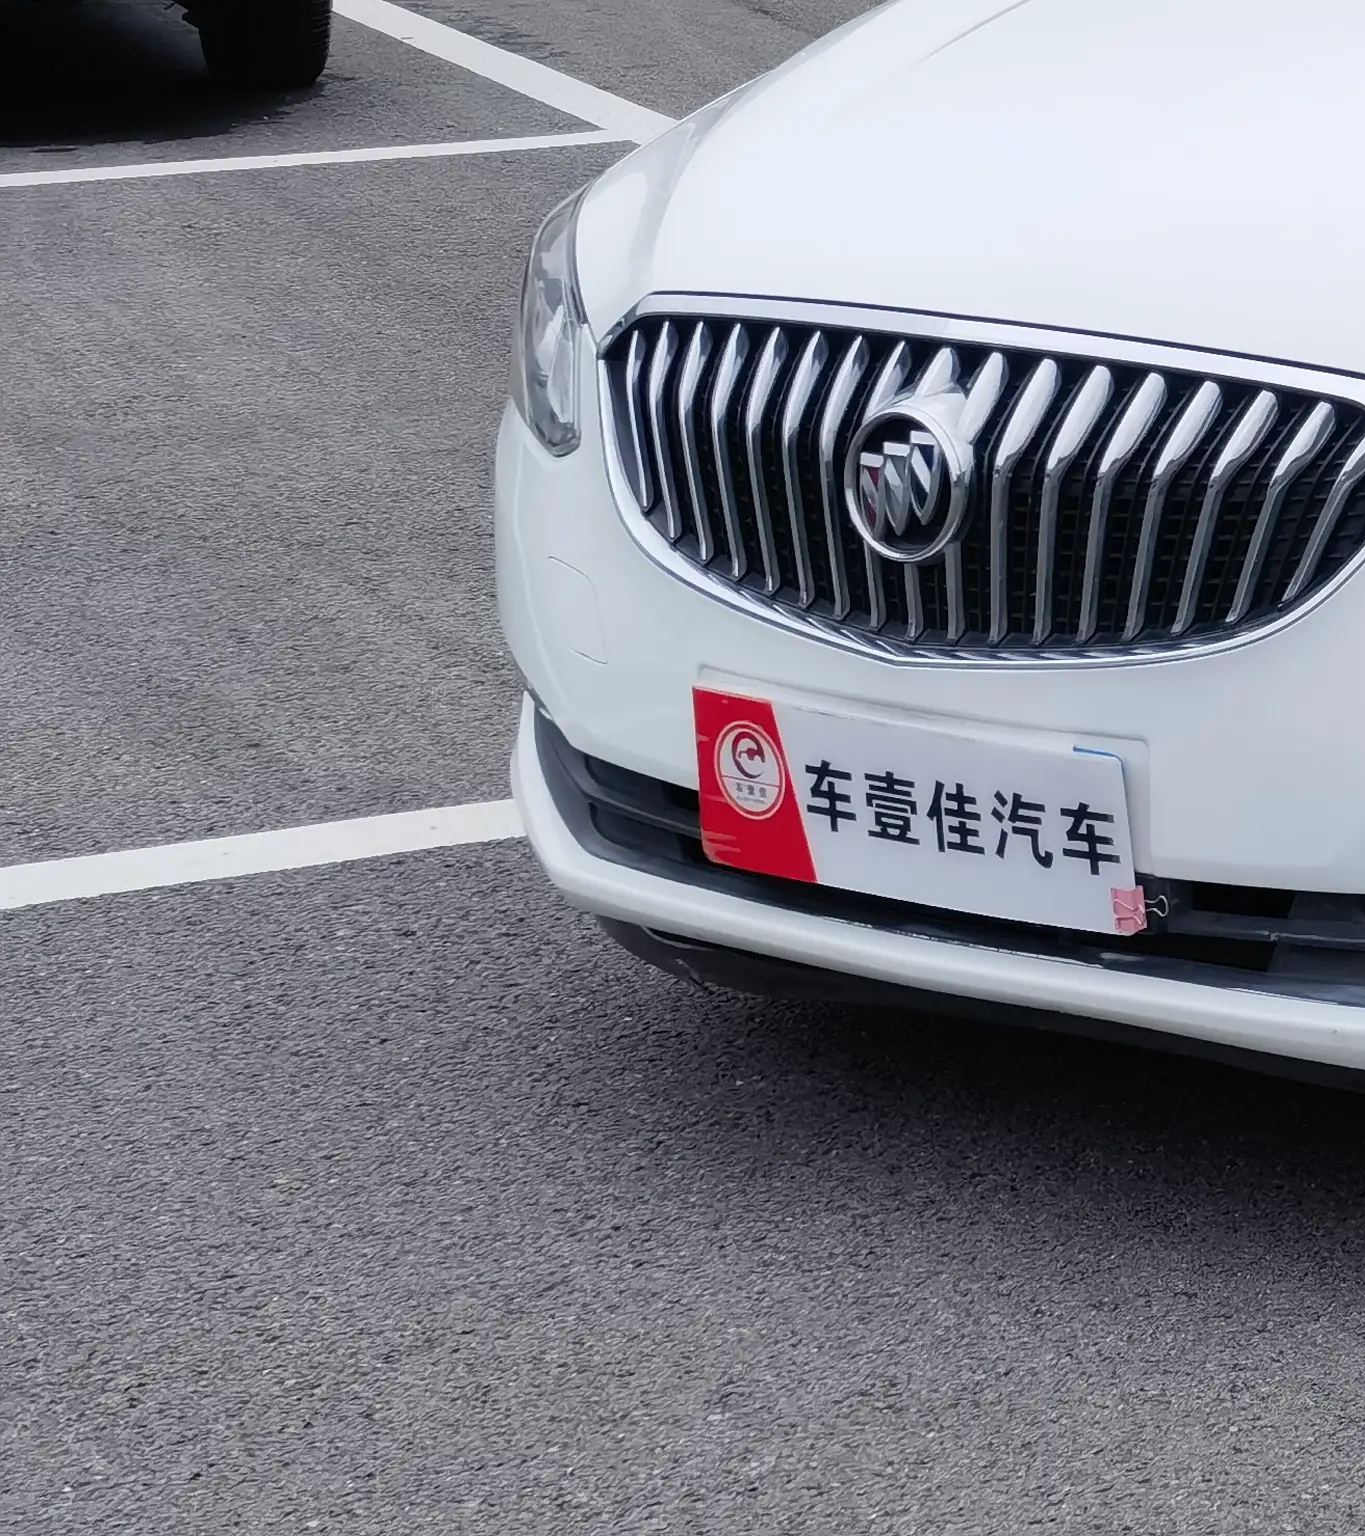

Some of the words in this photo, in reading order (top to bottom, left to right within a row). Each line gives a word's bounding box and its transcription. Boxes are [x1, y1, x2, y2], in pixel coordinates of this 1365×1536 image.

[804, 759, 1122, 876] 车壹佳汽车
